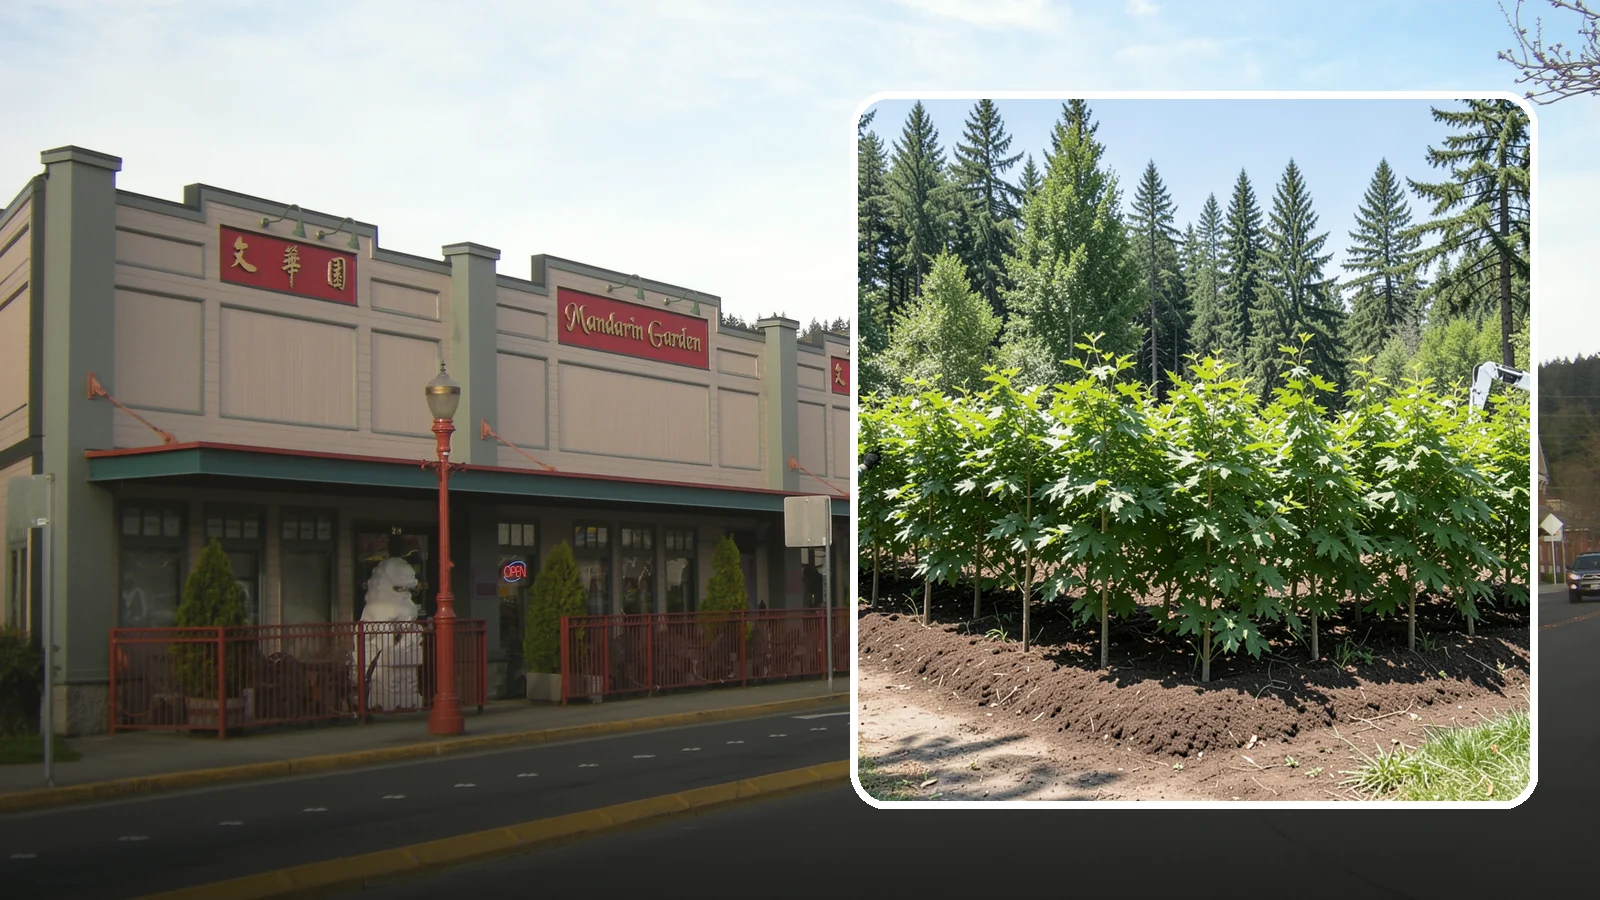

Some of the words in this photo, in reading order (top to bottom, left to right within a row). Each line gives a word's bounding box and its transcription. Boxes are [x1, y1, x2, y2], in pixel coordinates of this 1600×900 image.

[230, 235, 346, 291] 文華園
[564, 302, 644, 341] Mandarin
[648, 320, 702, 352] Garden
[834, 363, 846, 386] 文
[503, 565, 527, 578] OPEN
